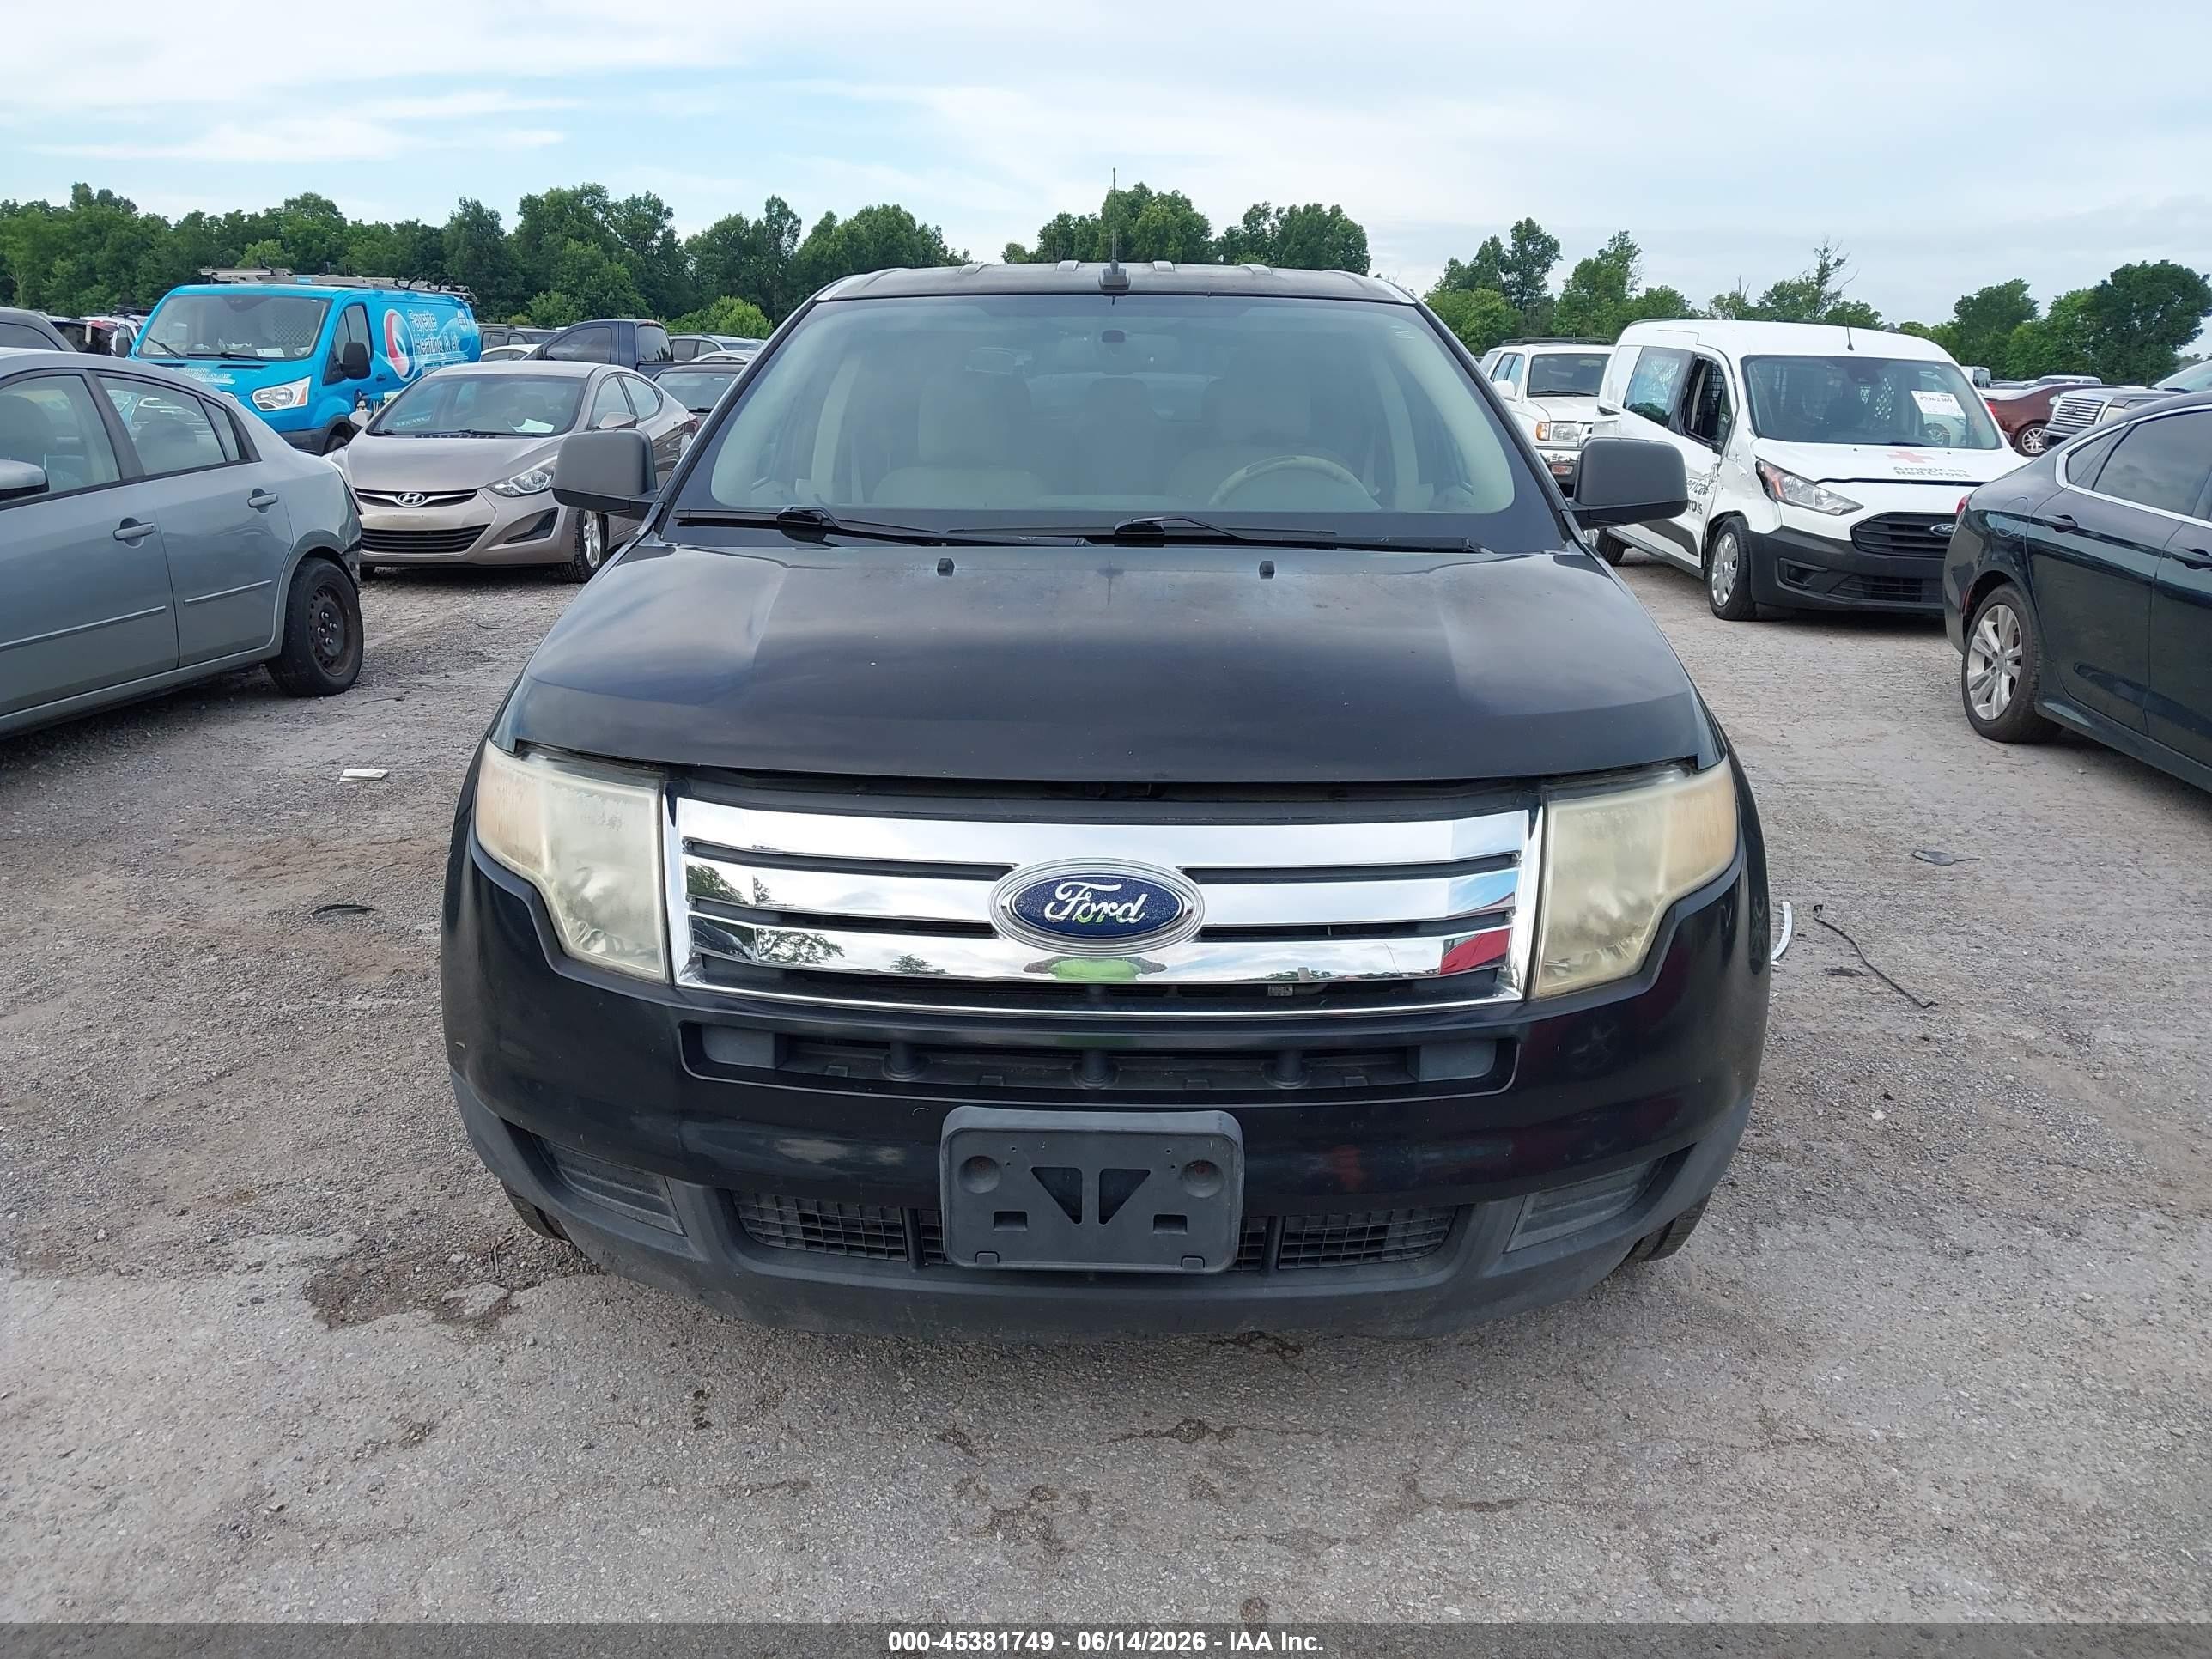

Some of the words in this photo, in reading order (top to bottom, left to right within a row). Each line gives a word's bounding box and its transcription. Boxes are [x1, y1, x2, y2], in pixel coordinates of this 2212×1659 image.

[407, 309, 437, 334] Fayette
[414, 333, 443, 356] Heating
[451, 331, 460, 352] Air
[1044, 881, 1148, 924] Ford
